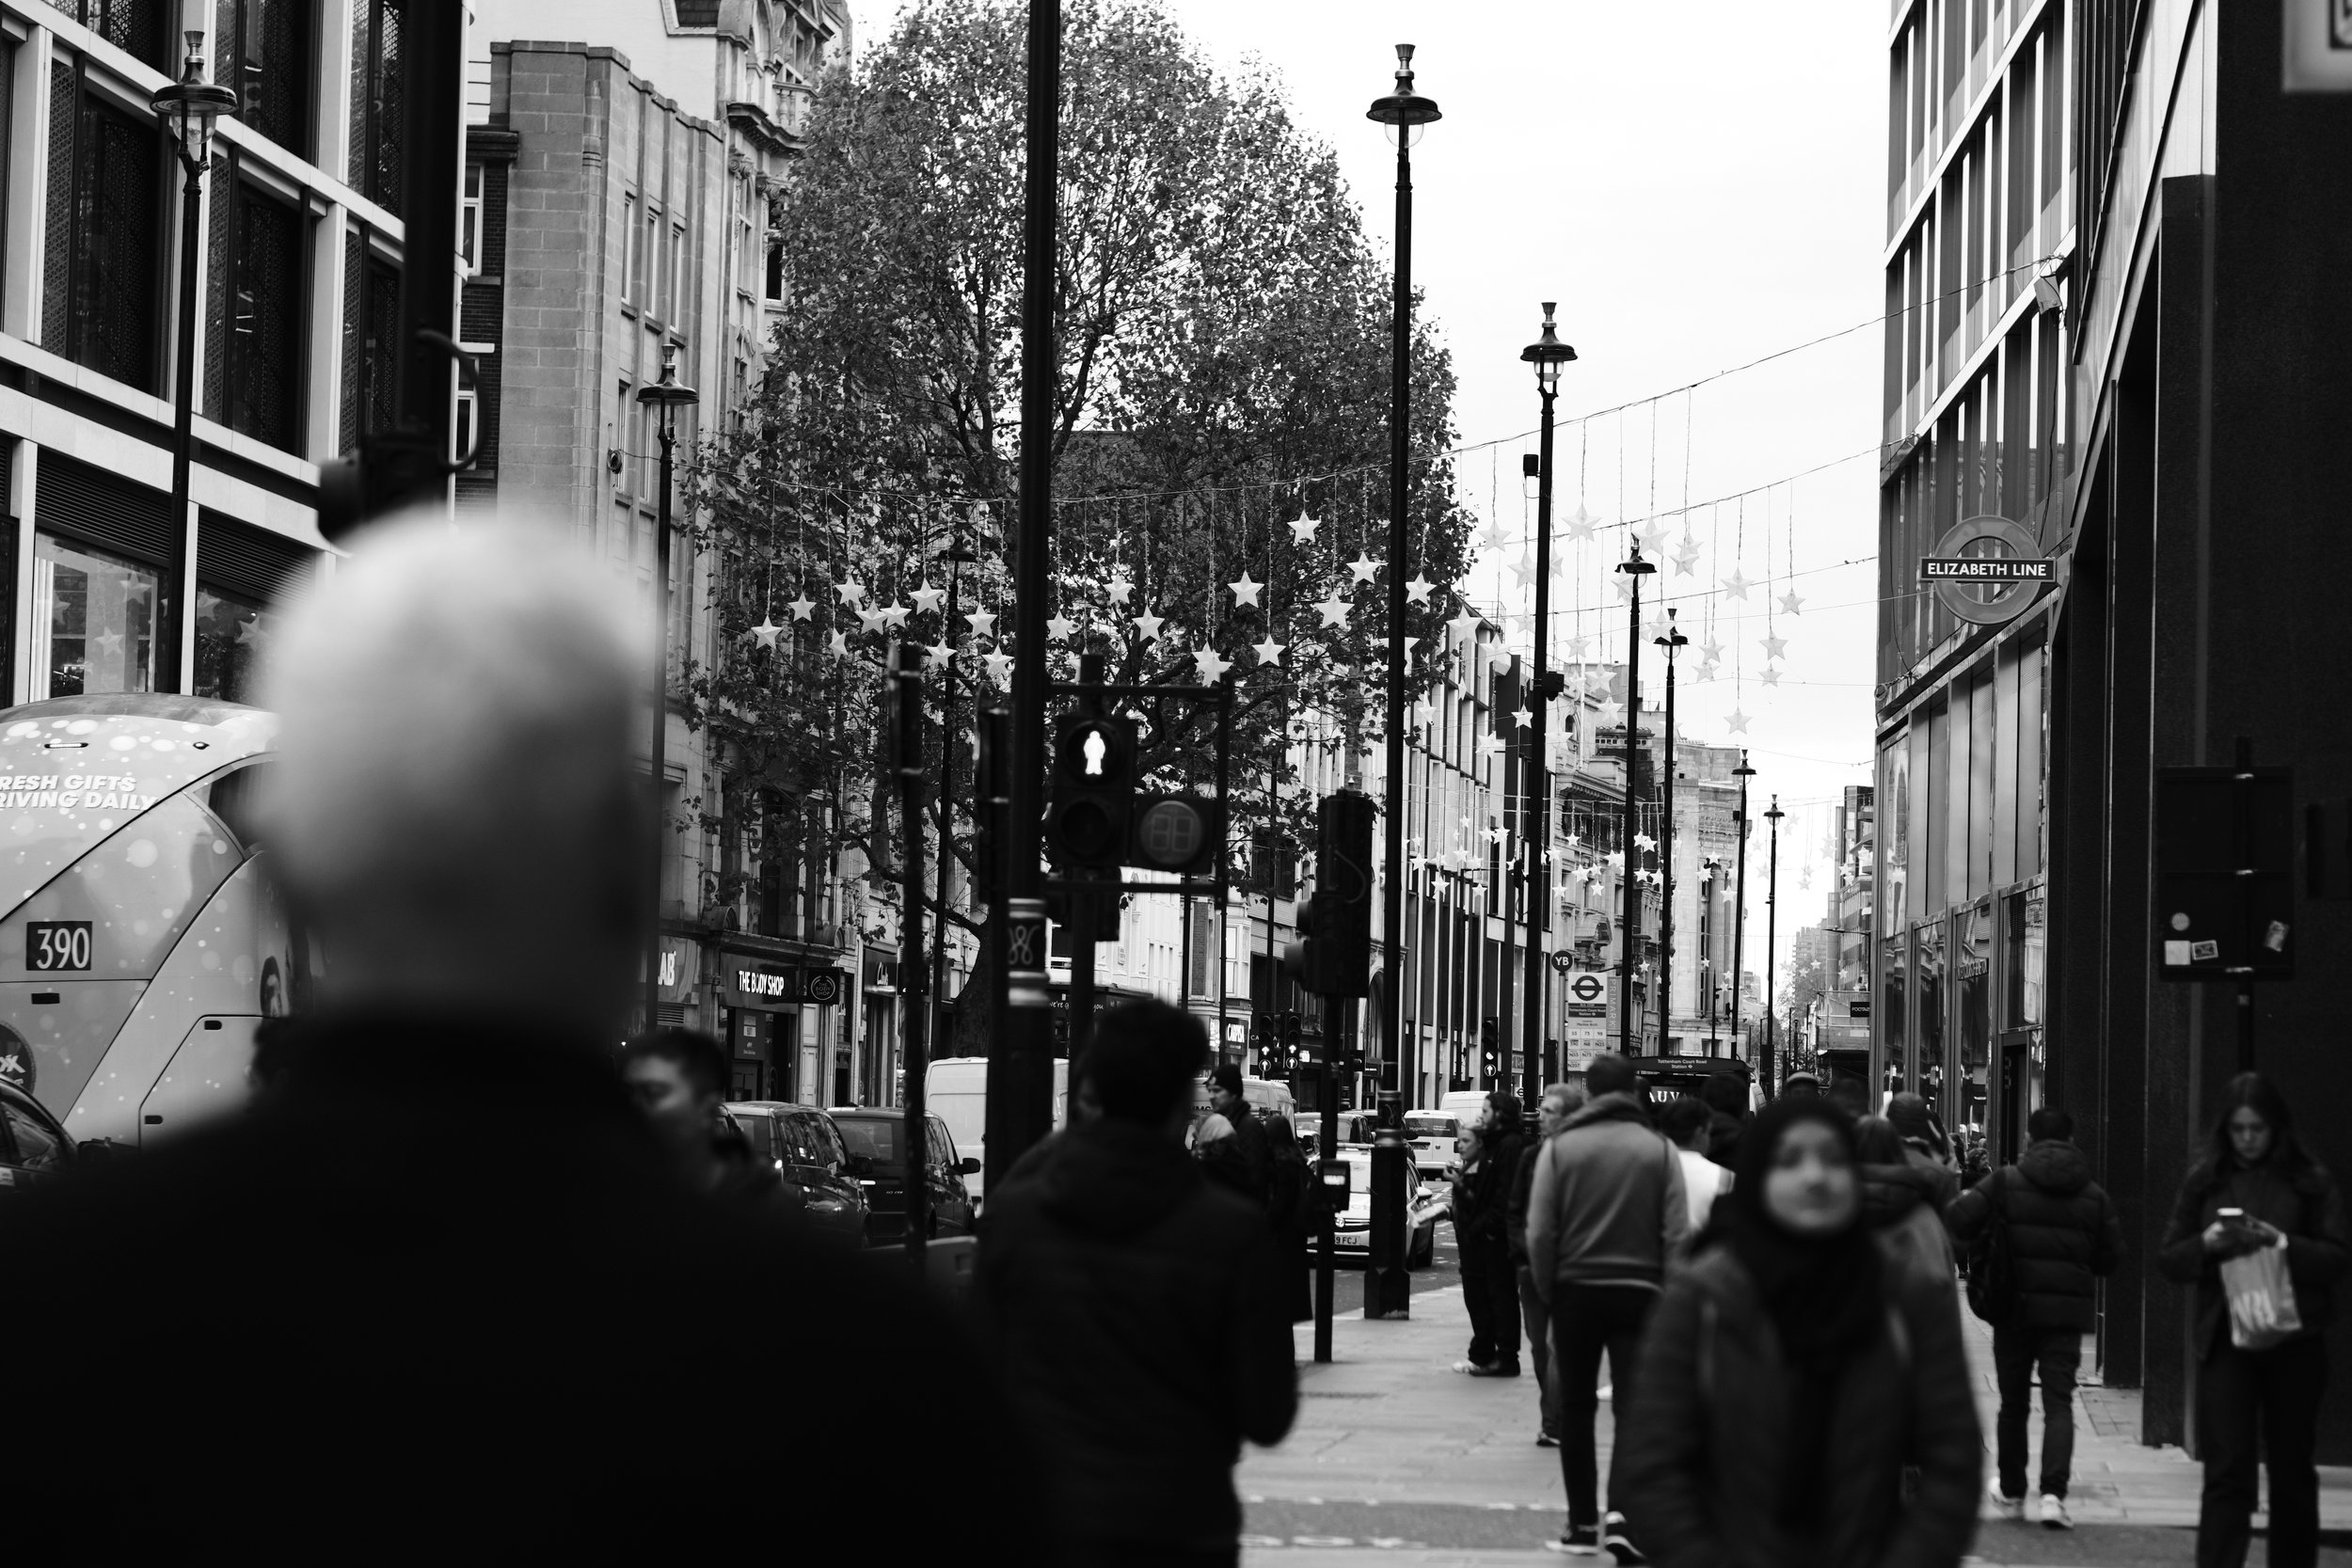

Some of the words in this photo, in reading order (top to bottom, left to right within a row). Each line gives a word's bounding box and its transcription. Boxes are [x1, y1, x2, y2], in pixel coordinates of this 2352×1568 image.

[1927, 562, 2008, 577] ELIZABETH
[2012, 563, 2047, 577] LINE
[64, 774, 137, 793] GIFTS
[85, 791, 160, 812] DAILY
[36, 927, 90, 970] 390
[1554, 956, 1569, 966] YB
[739, 970, 751, 992] THE
[751, 972, 768, 995] BODY
[768, 974, 785, 997] SHOP
[1342, 1236, 1358, 1244] FCJ
